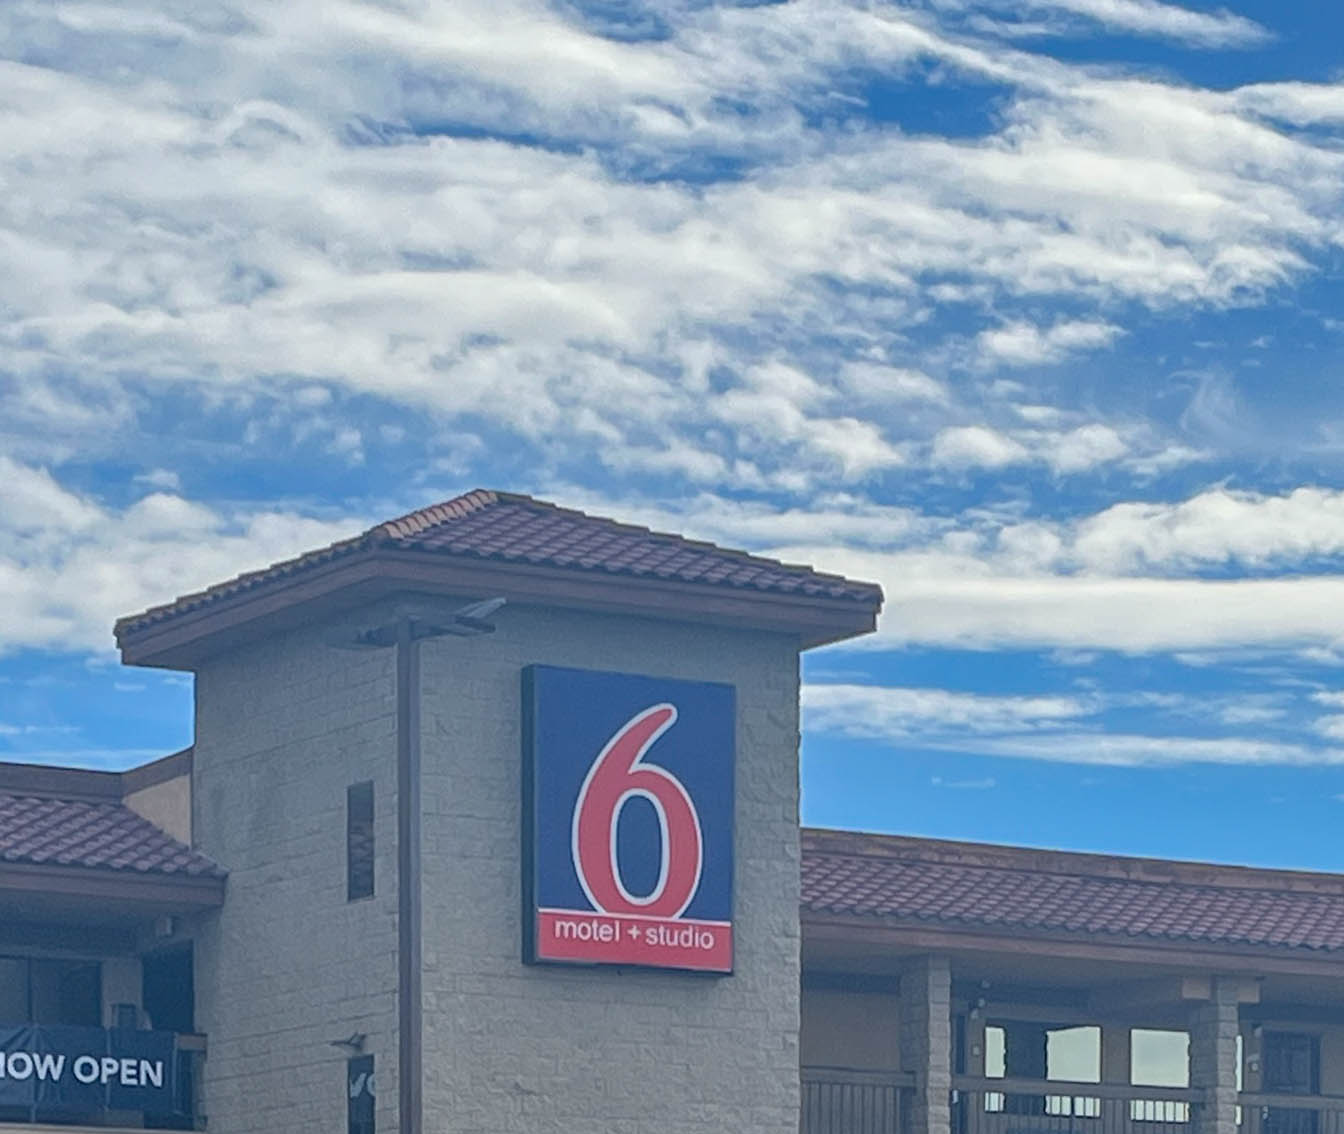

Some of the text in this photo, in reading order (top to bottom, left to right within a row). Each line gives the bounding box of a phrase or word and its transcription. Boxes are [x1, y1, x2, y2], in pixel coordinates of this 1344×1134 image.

[571, 702, 703, 920] 6
[555, 919, 620, 942] motel
[645, 925, 715, 949] studio
[73, 1055, 163, 1088] OPEN
